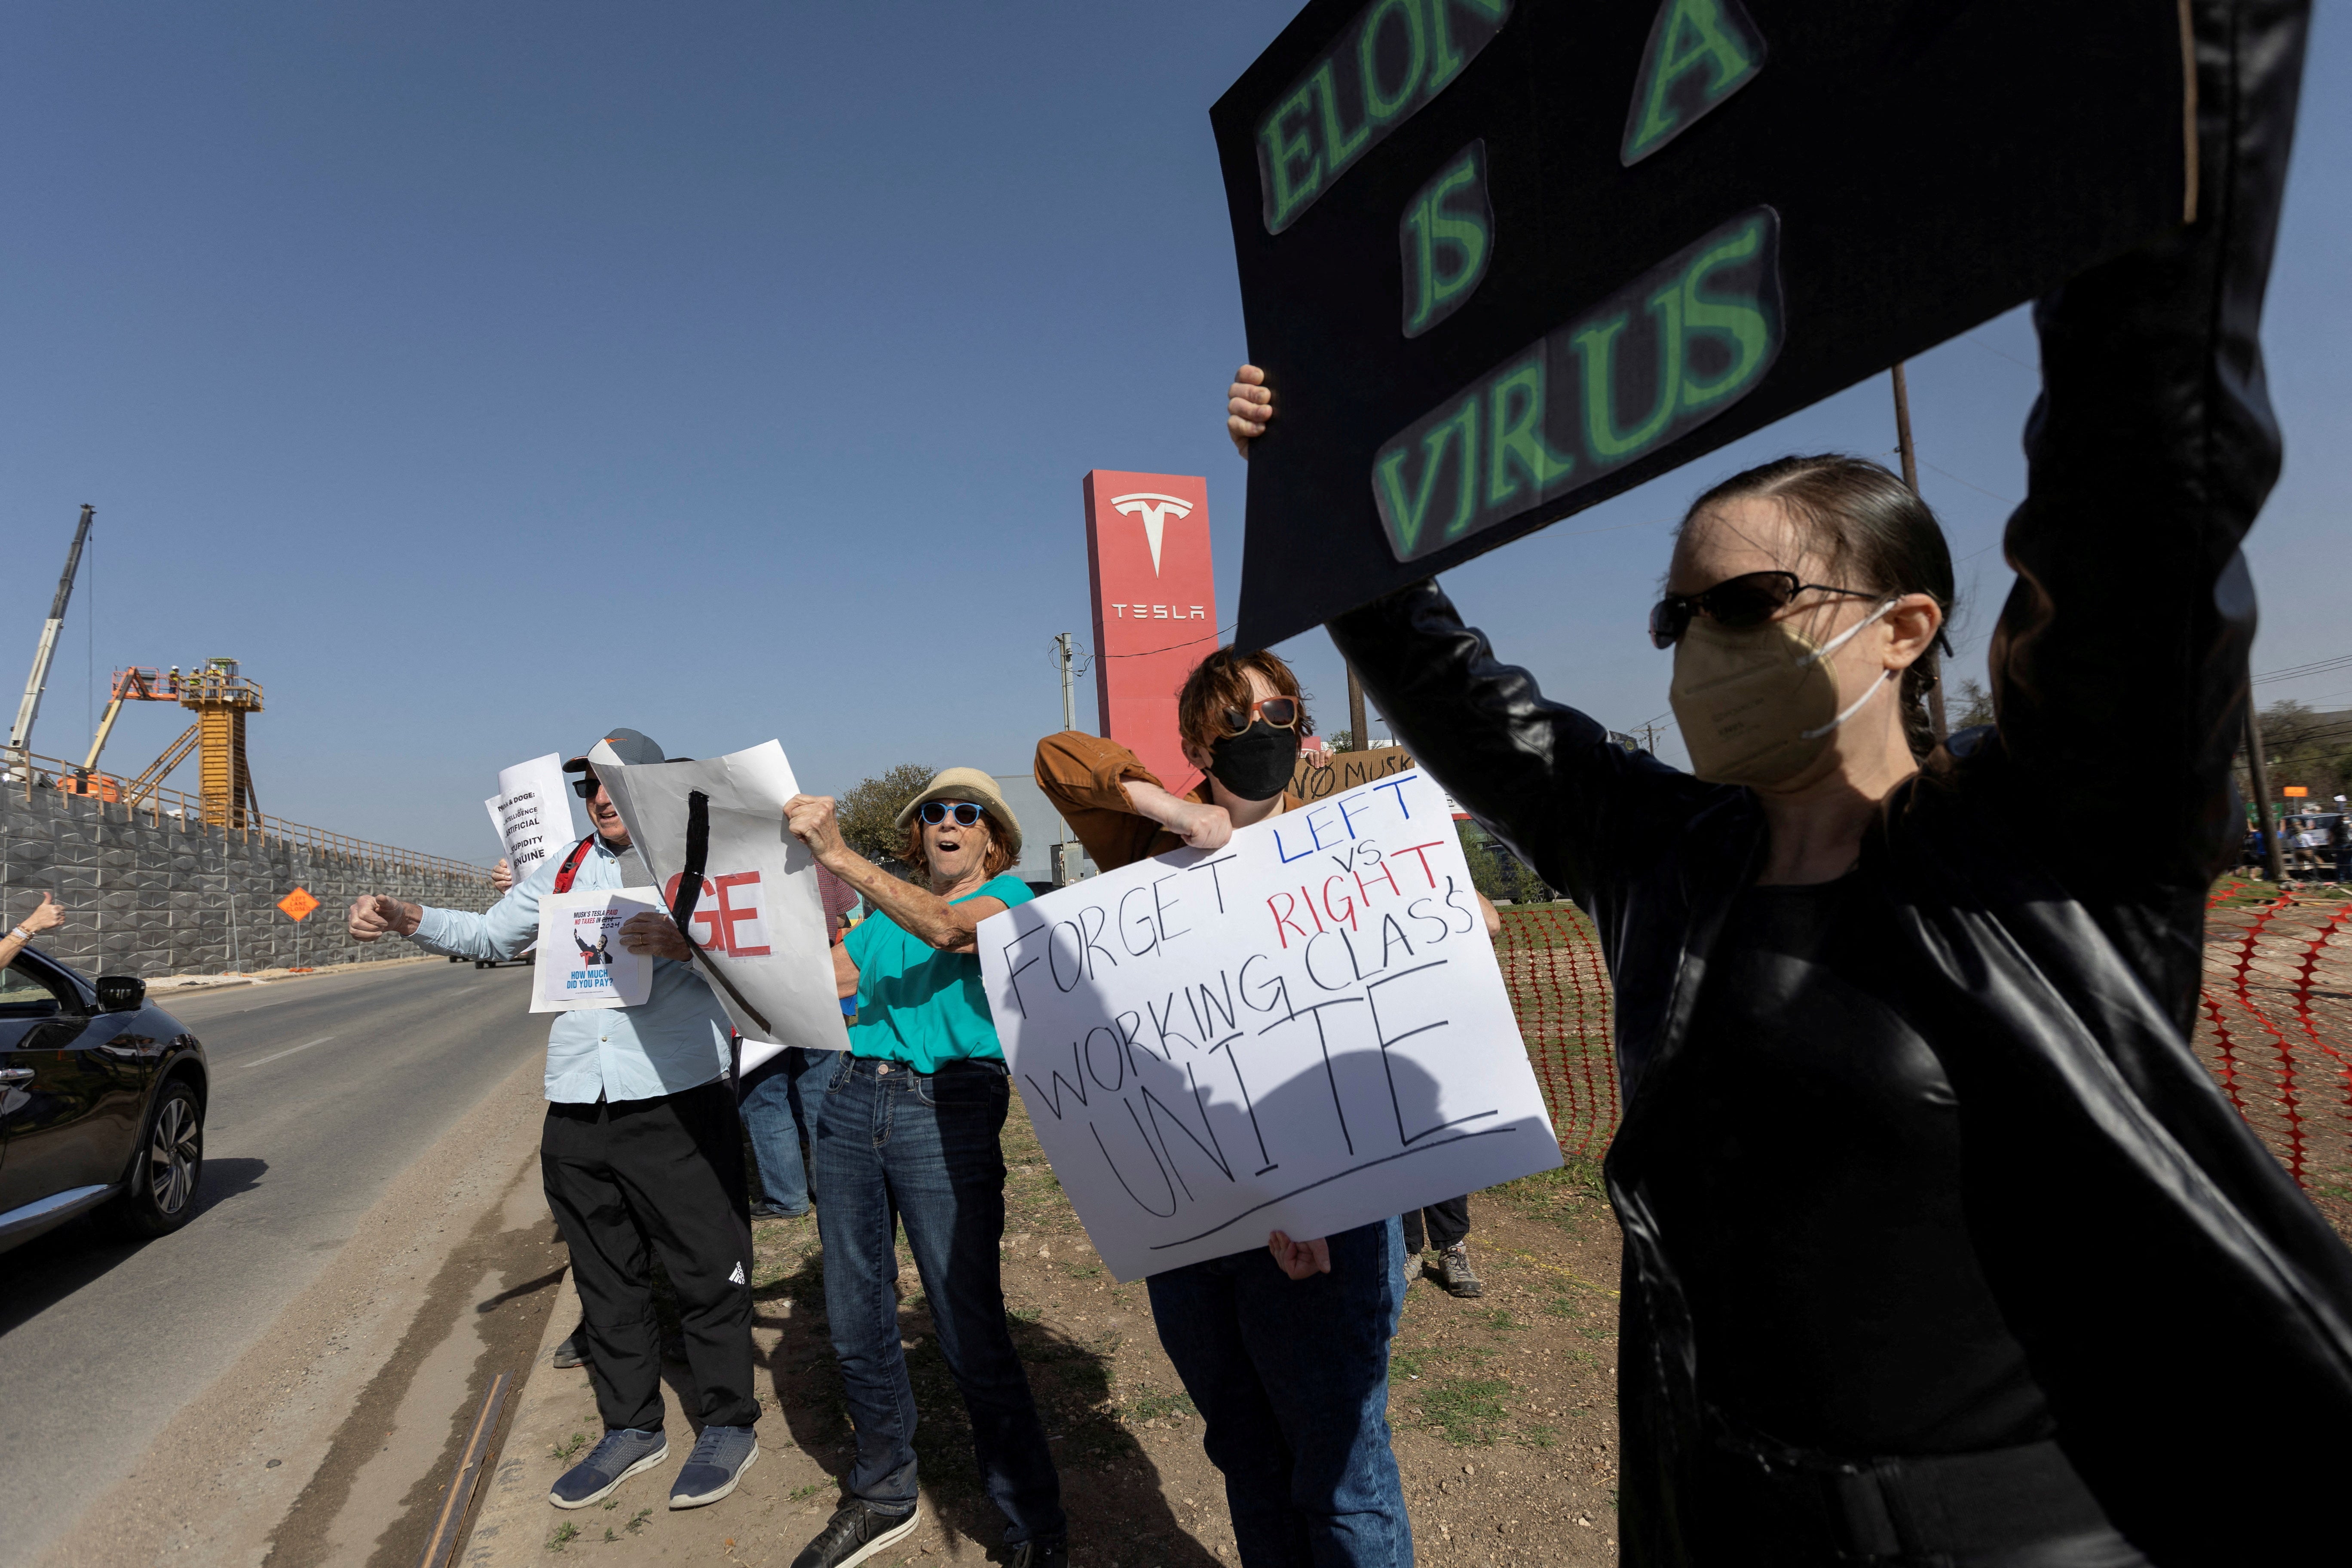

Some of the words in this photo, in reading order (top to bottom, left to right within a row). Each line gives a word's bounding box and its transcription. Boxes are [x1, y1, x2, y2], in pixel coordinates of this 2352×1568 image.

[1410, 160, 1485, 325] IS
[1633, 0, 1751, 151] A
[1380, 227, 1767, 552] VIRUS
[1112, 604, 1204, 620] TESLA
[1345, 754, 1411, 788] MUSK
[514, 792, 535, 803] DOGE:
[505, 807, 538, 824] INTELLIGENCE
[506, 818, 539, 837] ARTIFICIAL
[511, 835, 542, 852] STUPIDITY
[1004, 854, 1237, 1020] FORGET
[1274, 775, 1418, 864] LEFT
[567, 980, 577, 989] DID
[579, 979, 592, 988] YOU
[594, 977, 613, 987] PAY?
[571, 970, 585, 980] HOW
[588, 969, 608, 979] MUCH
[1024, 954, 1295, 1120] WORKING
[1305, 890, 1473, 991] CLASS
[1090, 959, 1498, 1218] UNITE
[736, 1261, 745, 1285] adidas
